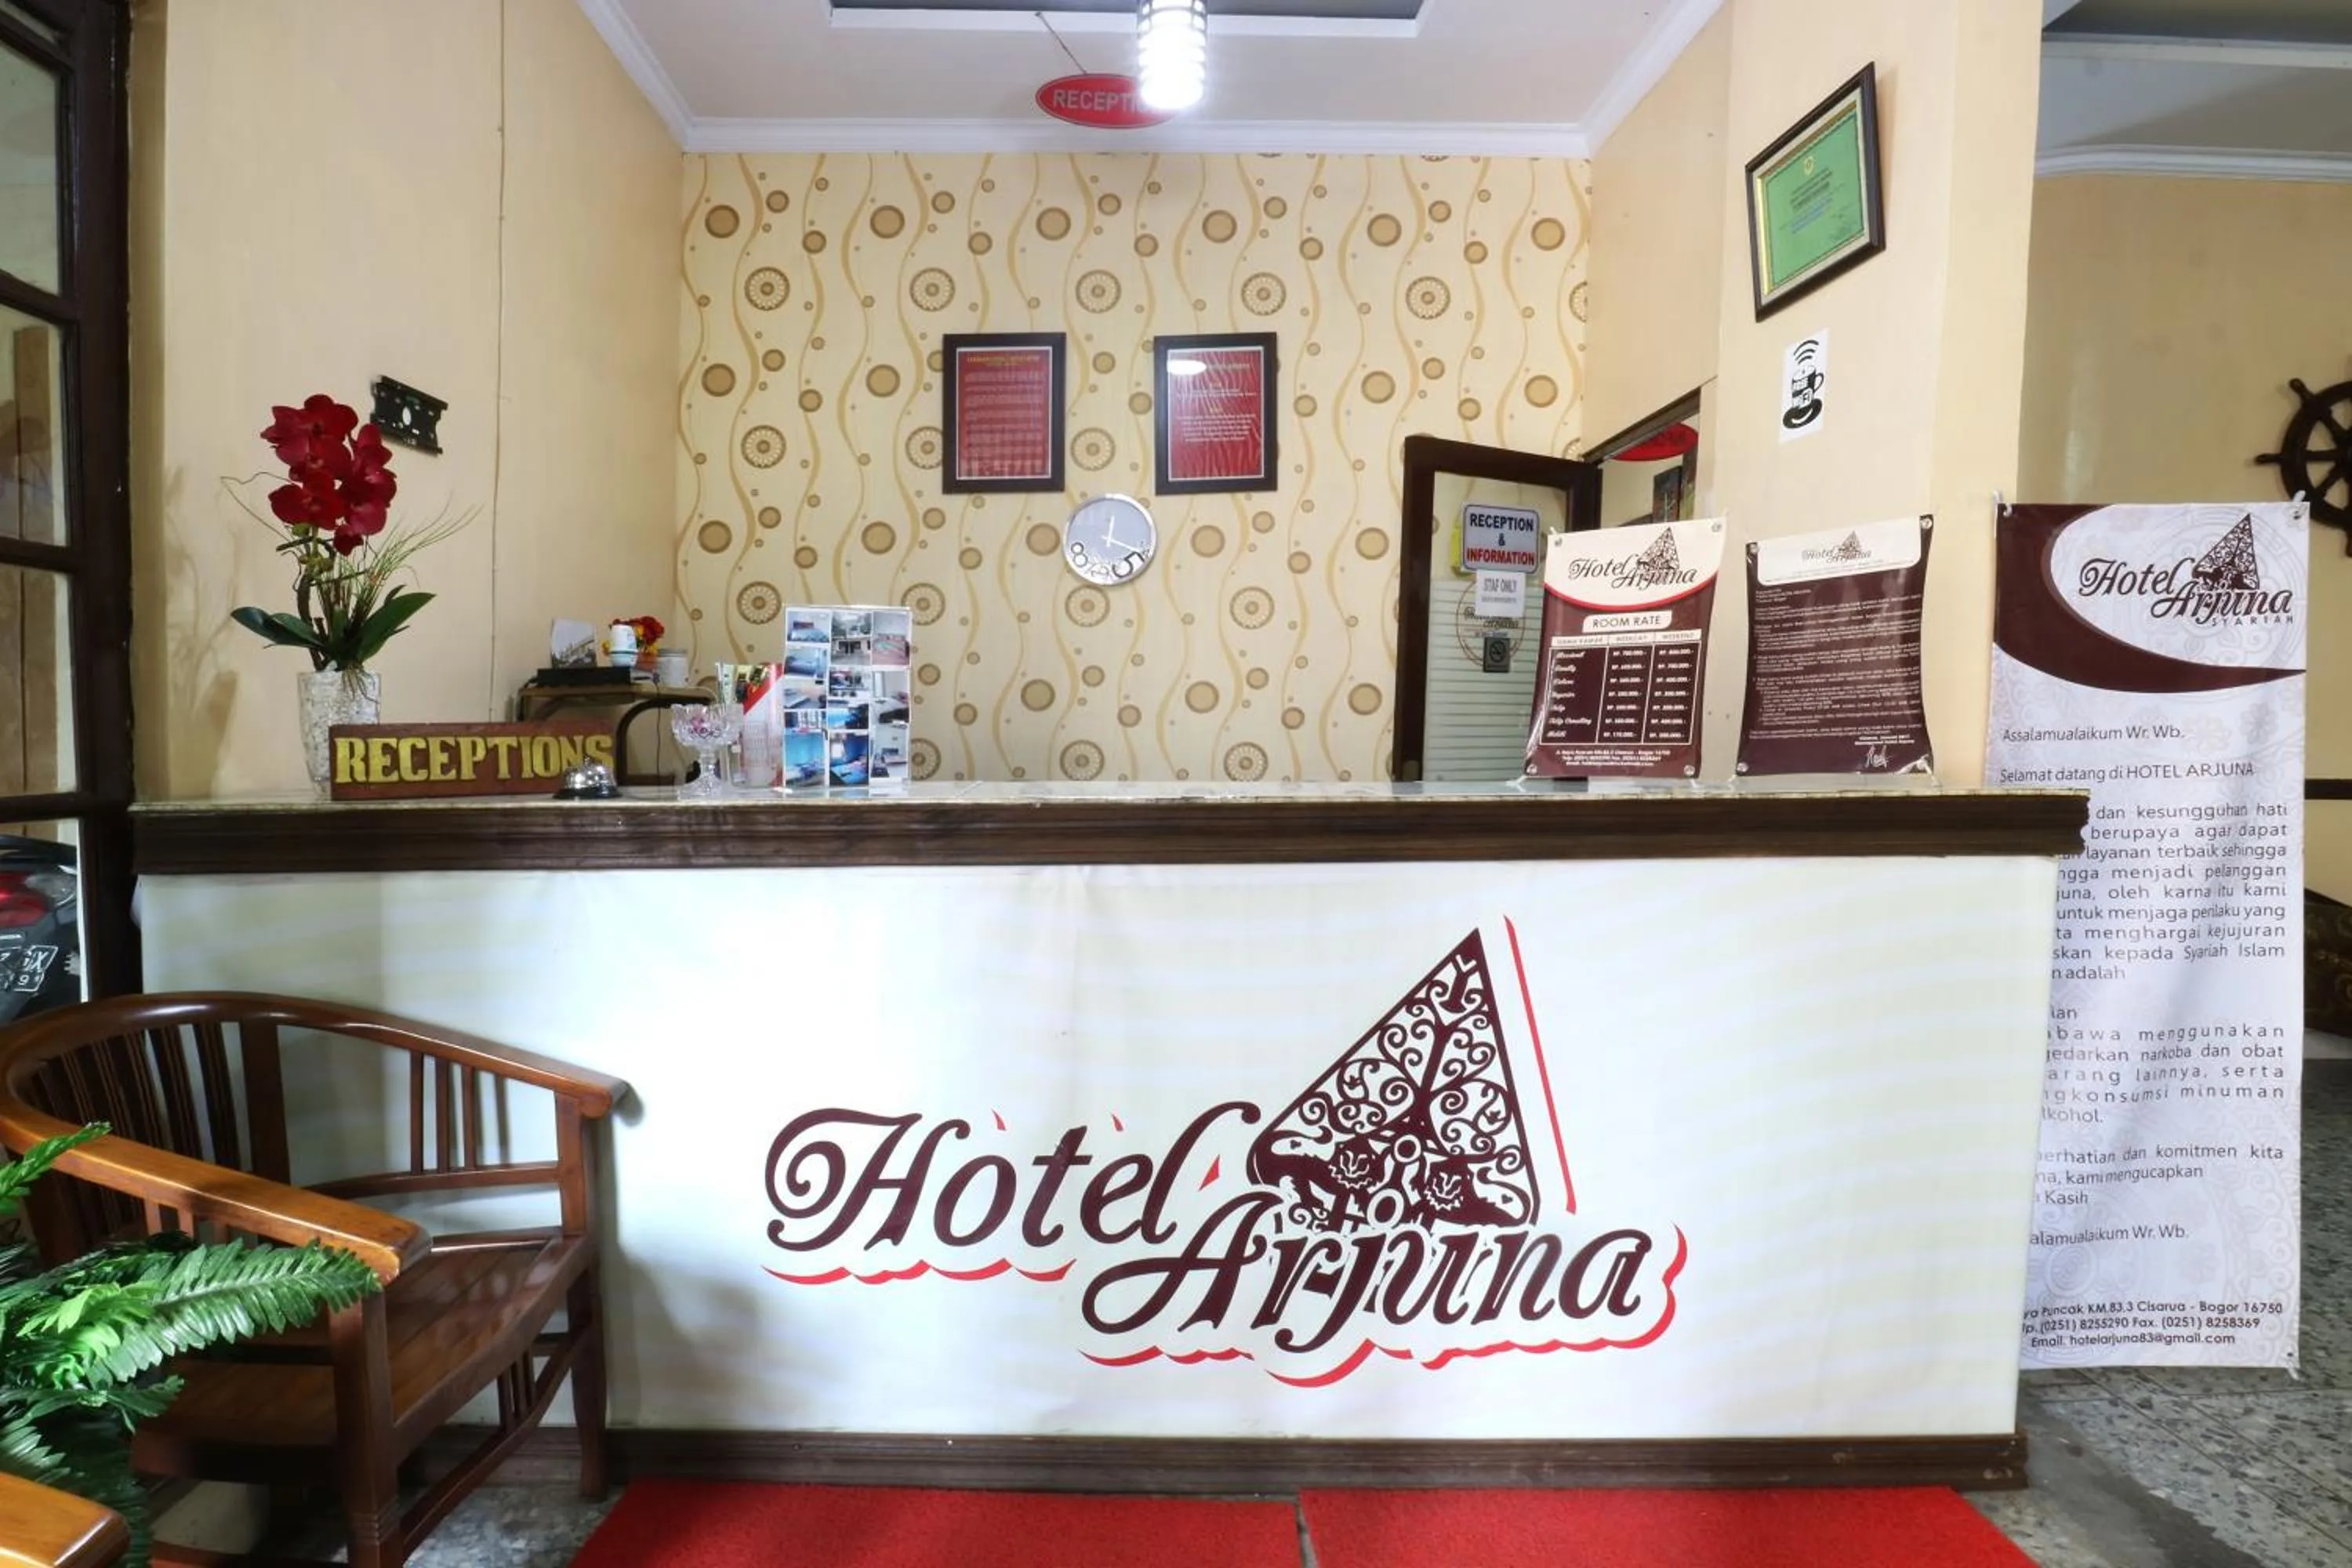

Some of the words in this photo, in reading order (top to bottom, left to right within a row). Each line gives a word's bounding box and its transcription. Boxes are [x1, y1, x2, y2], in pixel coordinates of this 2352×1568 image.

[1053, 89, 1145, 114] RECEPTI
[1470, 514, 1534, 531] RECEPTION
[1498, 533, 1505, 546] &
[1467, 548, 1534, 566] INFORMATION
[1569, 554, 1639, 579] Hotel
[1612, 567, 1697, 590] Arjuna
[2078, 557, 2195, 597] Hotel
[2151, 580, 2293, 624] Arjuna
[1592, 618, 1630, 629] ROOM
[1633, 615, 1661, 626] RATE
[2212, 616, 2294, 627] SYARIAH
[2003, 726, 2122, 742] Assalamualaikum
[2152, 724, 2185, 739] Wb.
[334, 734, 613, 784] RECEPTIONS
[2000, 768, 2052, 783] Selamat
[2055, 767, 2105, 782] datang
[2109, 765, 2123, 779] di
[2127, 764, 2182, 779] HOTEL
[2185, 762, 2255, 776] ARJUNA
[2096, 805, 2125, 819] dan
[2136, 803, 2248, 820] kesungguhan
[2256, 803, 2288, 816] hati
[2091, 826, 2180, 842] berupaya
[2194, 826, 2231, 840] agar
[2238, 823, 2288, 839] dapat
[2086, 845, 2151, 862] layanan
[2158, 844, 2219, 858] terbaik
[2222, 844, 2287, 859] sehingga
[2058, 869, 2099, 884] ngga
[2111, 865, 2193, 882] menjadi
[2205, 865, 2286, 882] pelanggan
[2056, 886, 2096, 902] juna,
[2108, 884, 2149, 899] oleh
[2165, 884, 2211, 899] karna
[2218, 884, 2234, 897] itu
[2244, 883, 2286, 897] kami
[2056, 906, 2103, 920] untuk
[2108, 904, 2187, 923] menjaga
[2245, 905, 2285, 920] yang
[2085, 927, 2200, 943] menghargai
[2208, 924, 2285, 941] kejujuran
[2053, 946, 2091, 960] skan
[2105, 946, 2173, 963] kepada
[2183, 945, 2227, 964] Syariah
[2239, 943, 2285, 957] Islam
[2066, 965, 2125, 979] adalah
[2140, 1023, 2285, 1042] menggunakan
[2046, 1047, 2129, 1062] edarkan
[2141, 1046, 2191, 1062] narkoba
[2201, 1045, 2230, 1058] dan
[2241, 1044, 2285, 1058] obat
[2048, 1069, 2121, 1086] arang
[2222, 1064, 2285, 1079] serta
[2180, 1084, 2285, 1098] minuman
[2042, 1104, 2103, 1123] lkohol.
[2038, 1148, 2115, 1164] erhatian
[2122, 1146, 2147, 1161] dan
[2157, 1145, 2237, 1159] komitmen
[2250, 1145, 2284, 1160] kita
[765, 1101, 1260, 1253] Hotel
[2066, 1170, 2103, 1185] kami
[2105, 1166, 2203, 1184] mengucapkan
[2045, 1190, 2089, 1205] Kasih
[2030, 1228, 2129, 1246] alamualaikum
[2158, 1224, 2190, 1239] Wb.
[1080, 1187, 1653, 1355] Arjuna
[2042, 1304, 2083, 1317] Puncak
[2136, 1301, 2185, 1312] Cisarua
[2199, 1301, 2238, 1314] Bogor
[2244, 1302, 2283, 1314] 16750
[2041, 1319, 2076, 1334] (0251)
[2080, 1317, 2129, 1330] 8255290
[2161, 1316, 2202, 1330] (0251)
[2205, 1317, 2260, 1329] 8258369
[2070, 1332, 2236, 1347] hotelarjuna83@gmail.com
